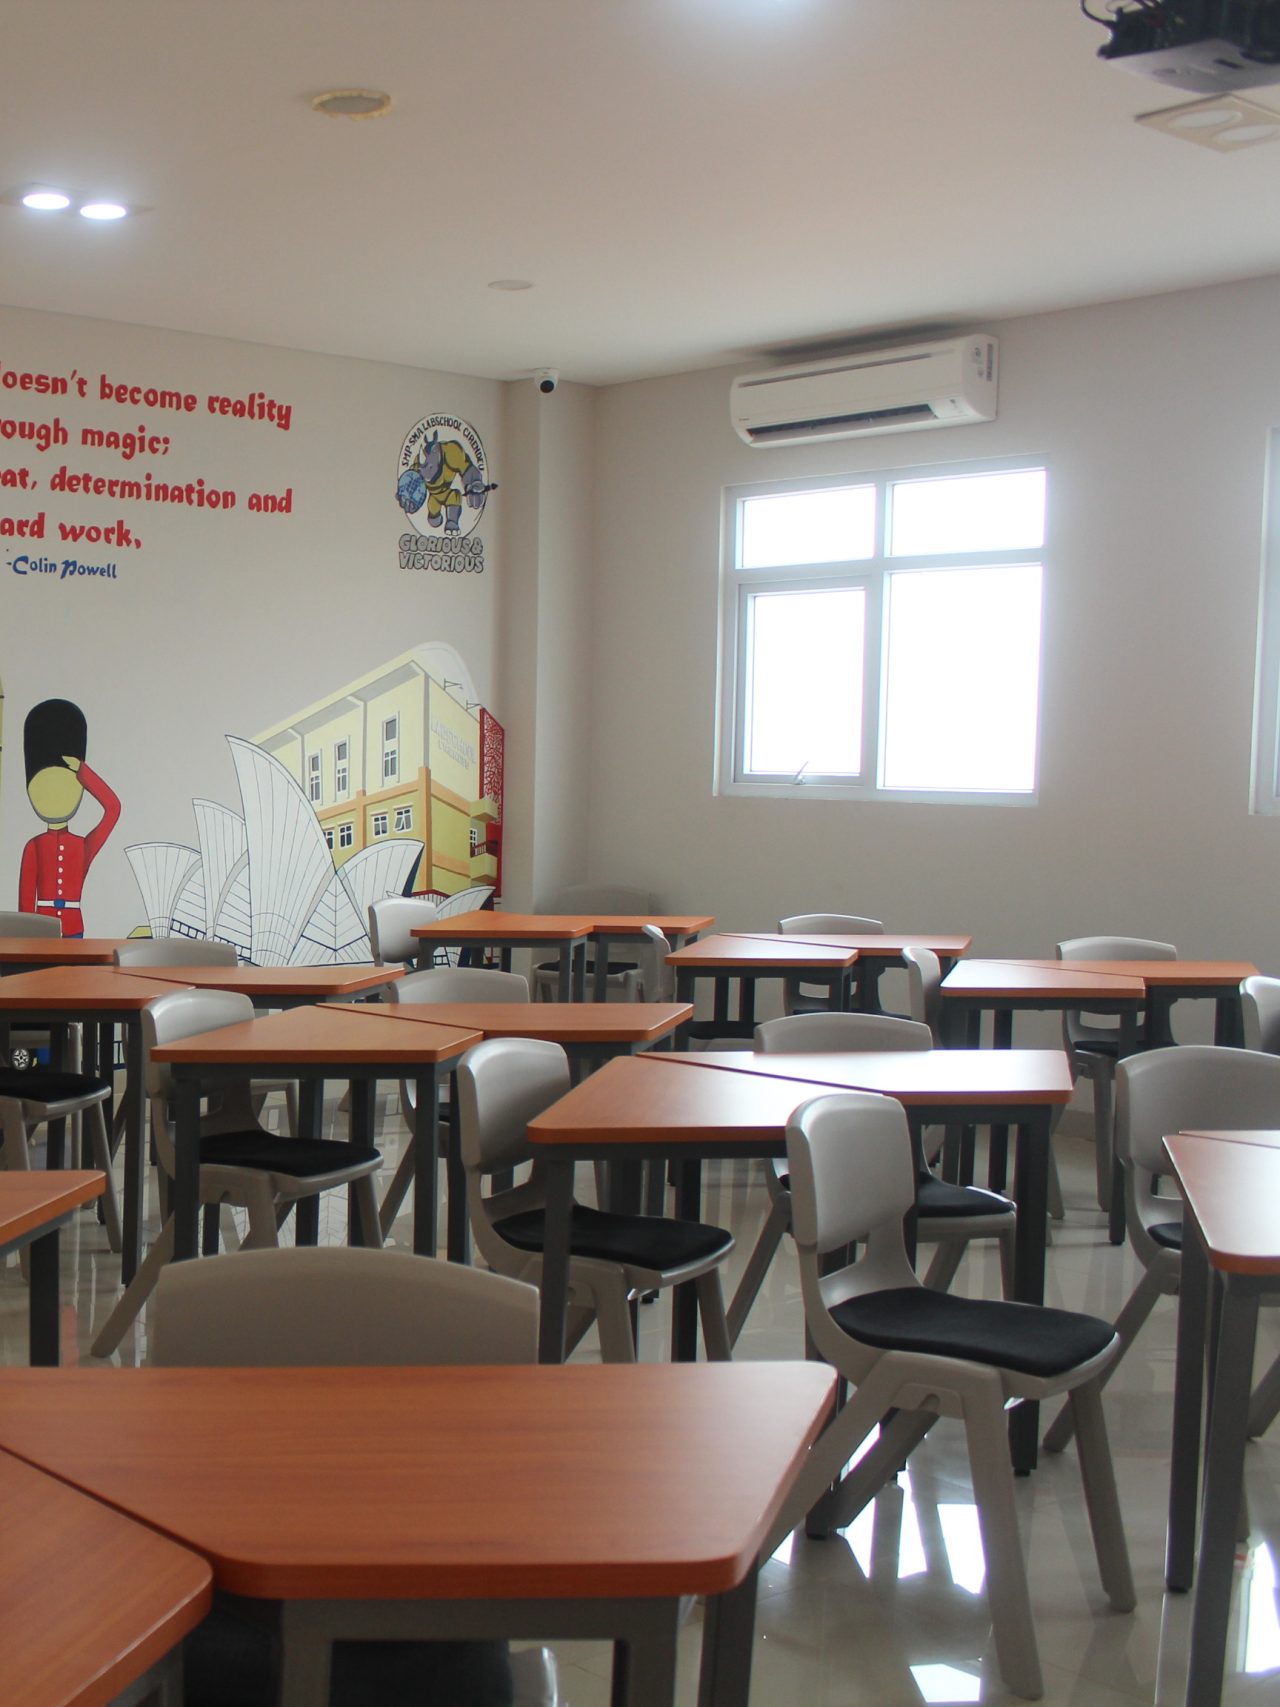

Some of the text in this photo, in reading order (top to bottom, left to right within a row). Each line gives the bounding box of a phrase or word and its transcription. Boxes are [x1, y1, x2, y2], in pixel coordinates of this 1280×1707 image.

[100, 374, 197, 412] become
[207, 392, 292, 431] reality
[81, 424, 170, 460] magic;
[422, 415, 462, 432] LABSCHOOL
[462, 427, 485, 472] CIRENDEU
[50, 465, 236, 509] determination
[248, 488, 293, 513] and
[398, 551, 485, 573] VICTORIOUS
[399, 533, 484, 556] GLORIOUS &
[60, 559, 118, 579] Powell
